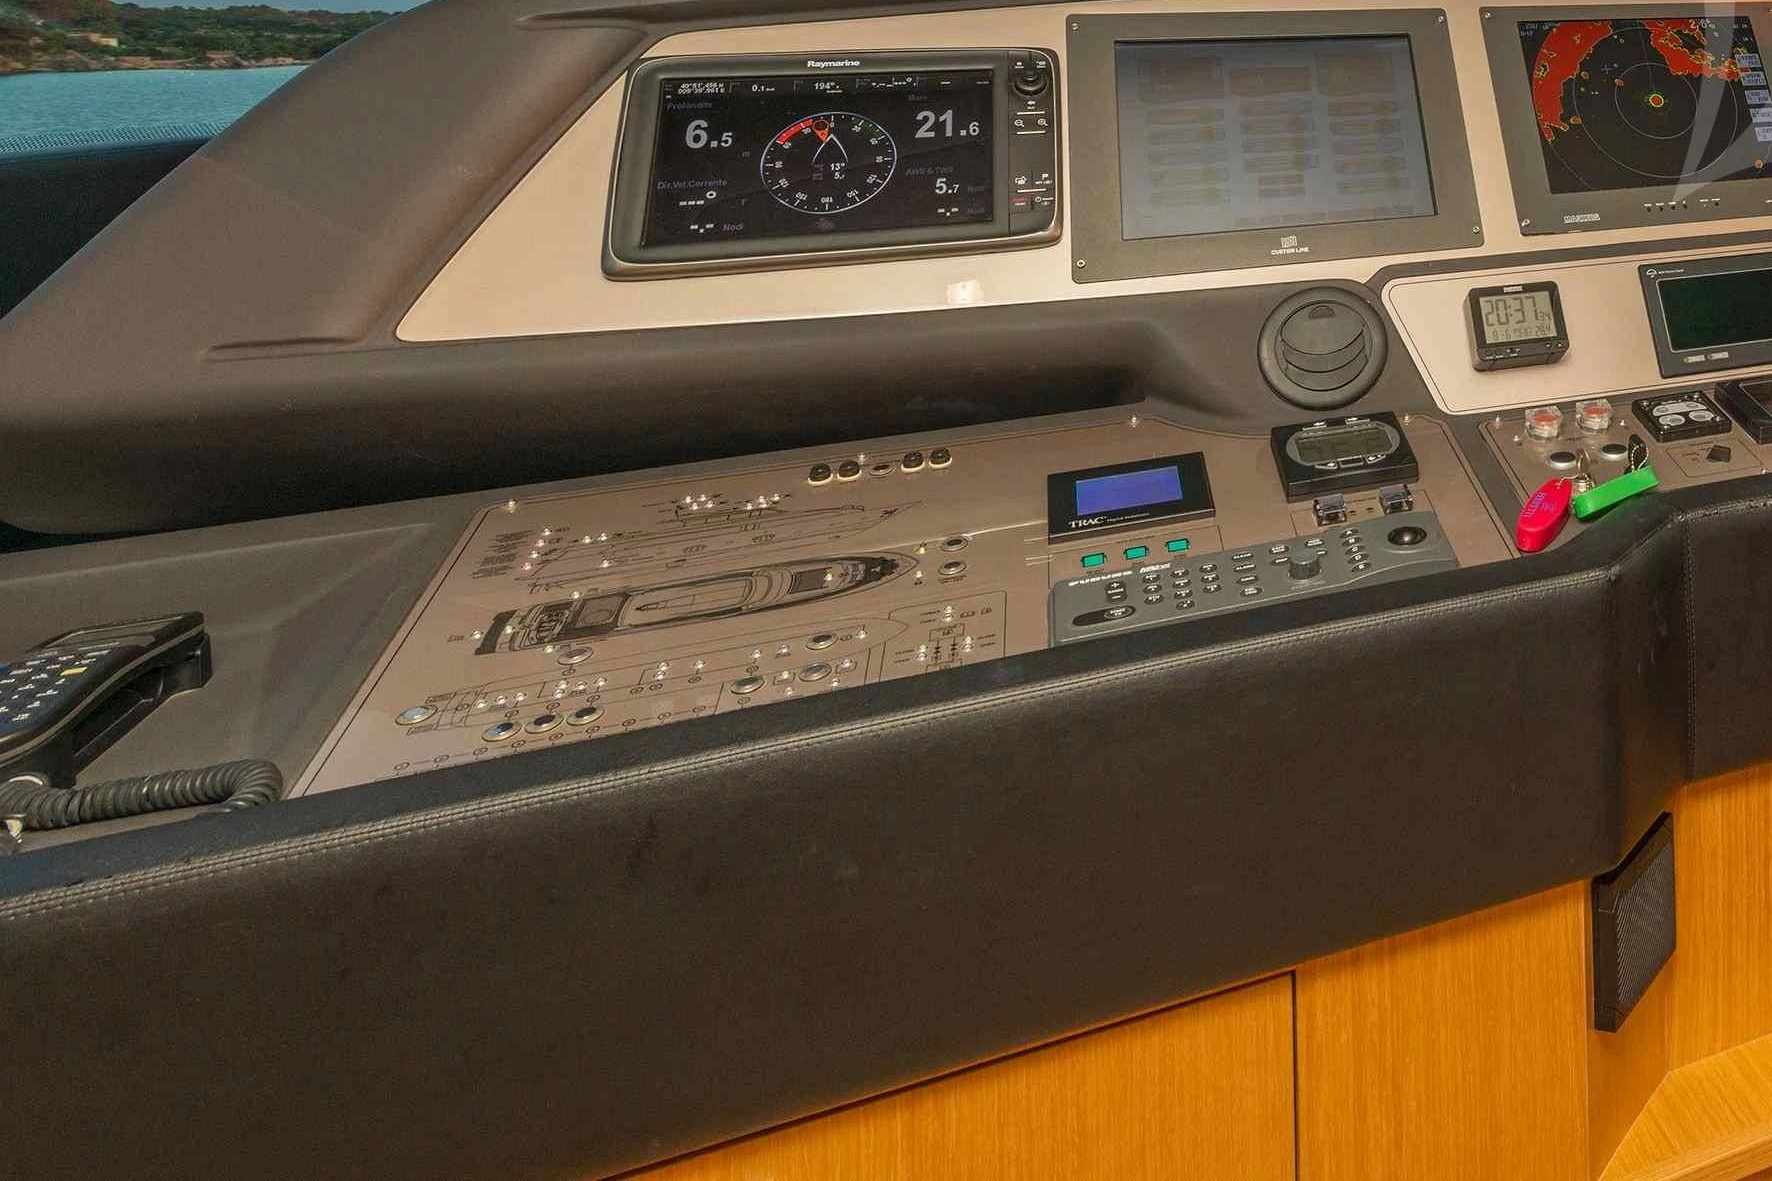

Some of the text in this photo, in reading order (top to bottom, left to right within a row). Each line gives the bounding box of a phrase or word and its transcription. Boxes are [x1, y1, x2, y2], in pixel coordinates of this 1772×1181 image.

[807, 59, 860, 70] Raymarine
[935, 177, 960, 195] 5.7
[1483, 295, 1539, 327] 20:37
[1068, 516, 1105, 529] TRAC
